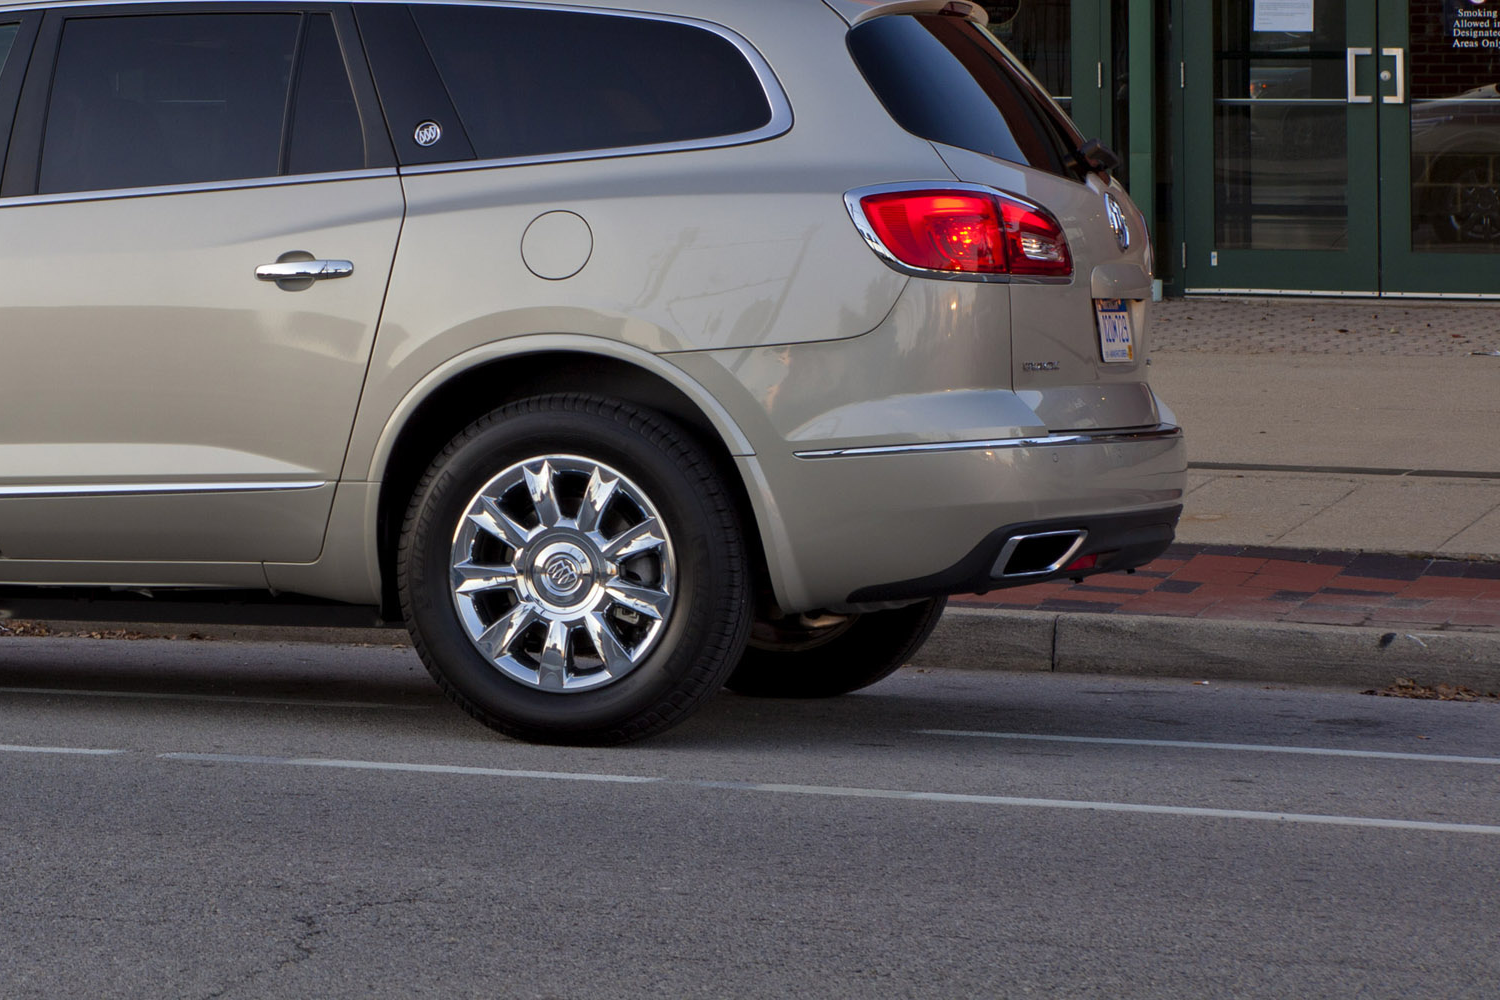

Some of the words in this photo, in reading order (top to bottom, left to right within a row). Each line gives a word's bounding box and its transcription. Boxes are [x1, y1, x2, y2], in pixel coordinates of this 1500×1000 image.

[1457, 8, 1498, 19] Smoking
[1453, 19, 1490, 28] Allowed
[1452, 39, 1479, 48] Areas
